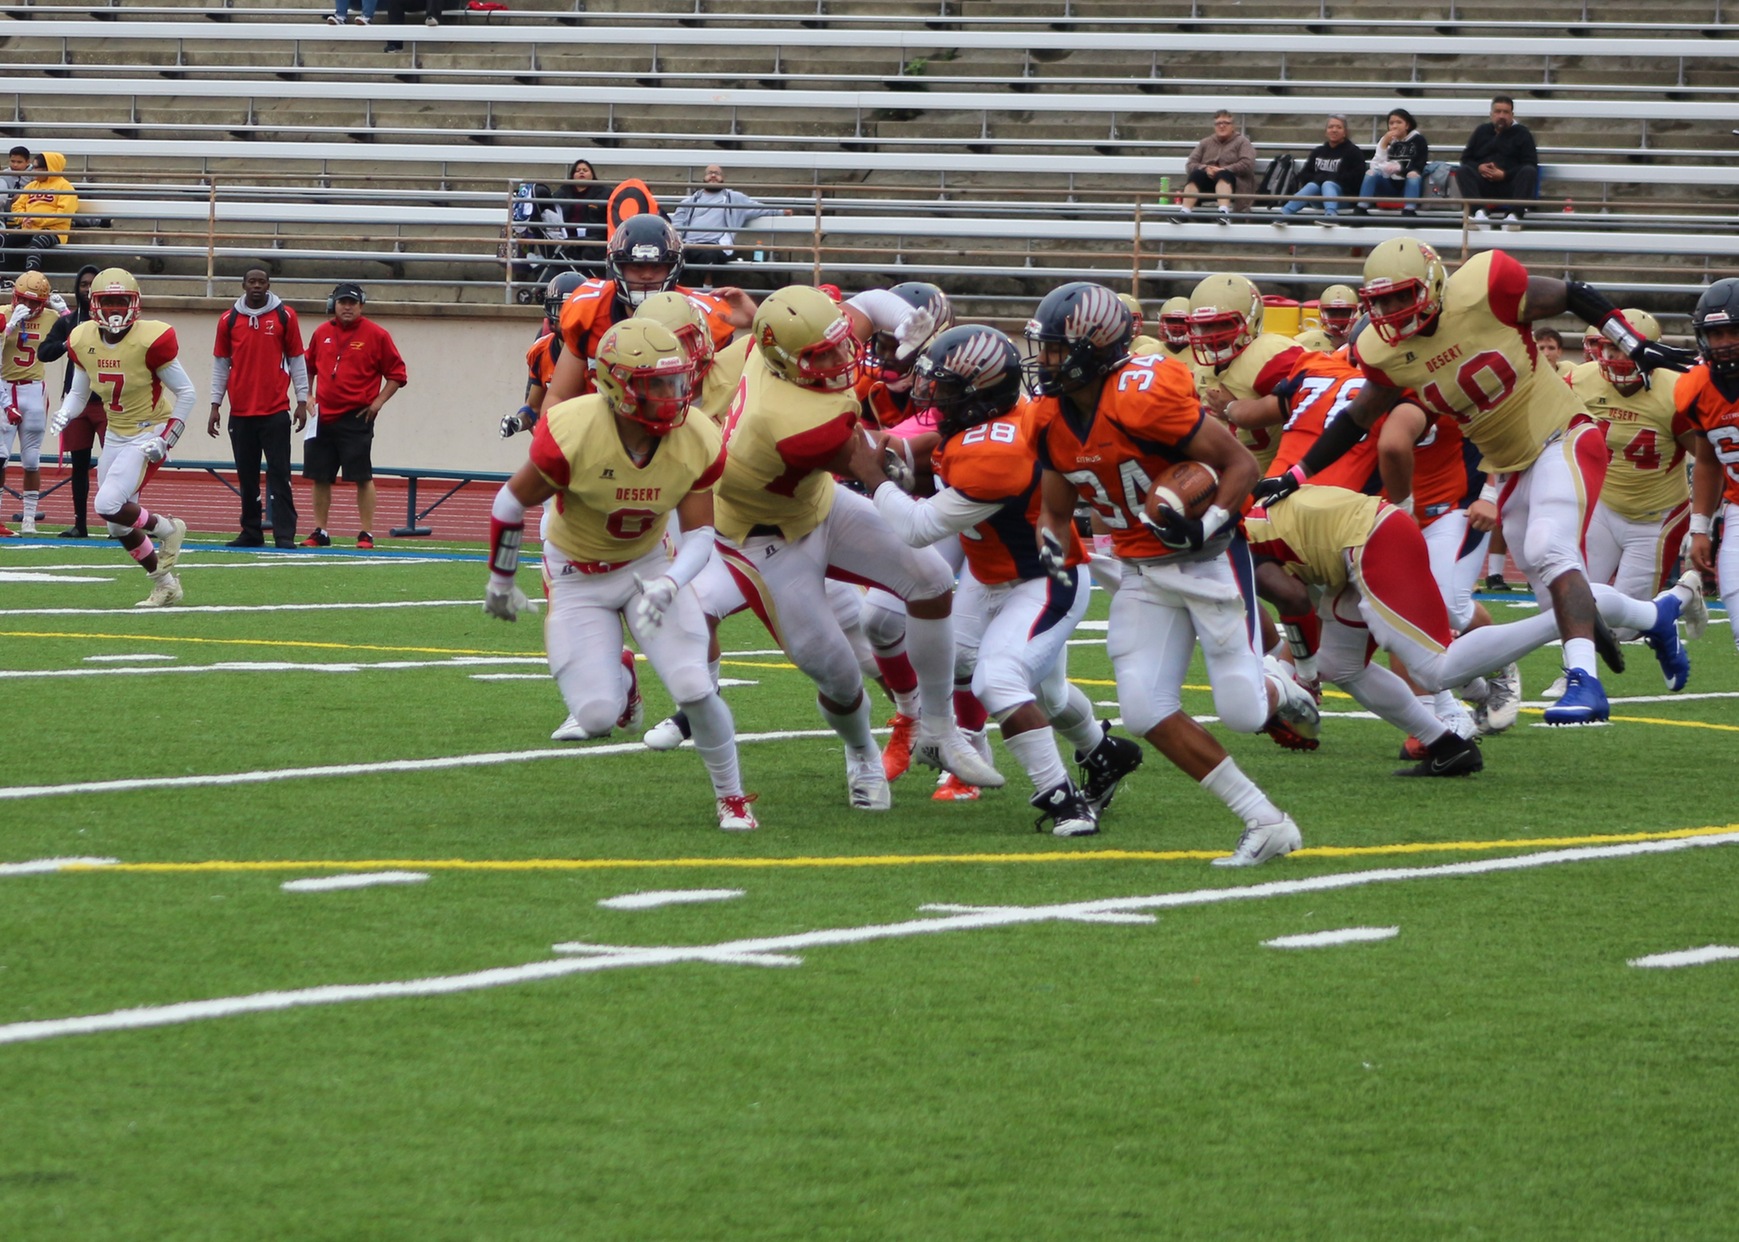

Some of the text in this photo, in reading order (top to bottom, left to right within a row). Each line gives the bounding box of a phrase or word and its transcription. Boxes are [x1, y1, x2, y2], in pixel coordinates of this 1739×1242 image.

[13, 331, 41, 368] 5
[97, 359, 121, 369] DESERT
[1425, 344, 1464, 373] DESERT
[1118, 353, 1165, 391] 34
[1422, 349, 1518, 425] 10
[98, 372, 125, 412] 7
[1609, 407, 1639, 422] DESERT
[961, 421, 1017, 446] 28
[615, 487, 662, 501] DESERT
[1062, 459, 1152, 529] 34
